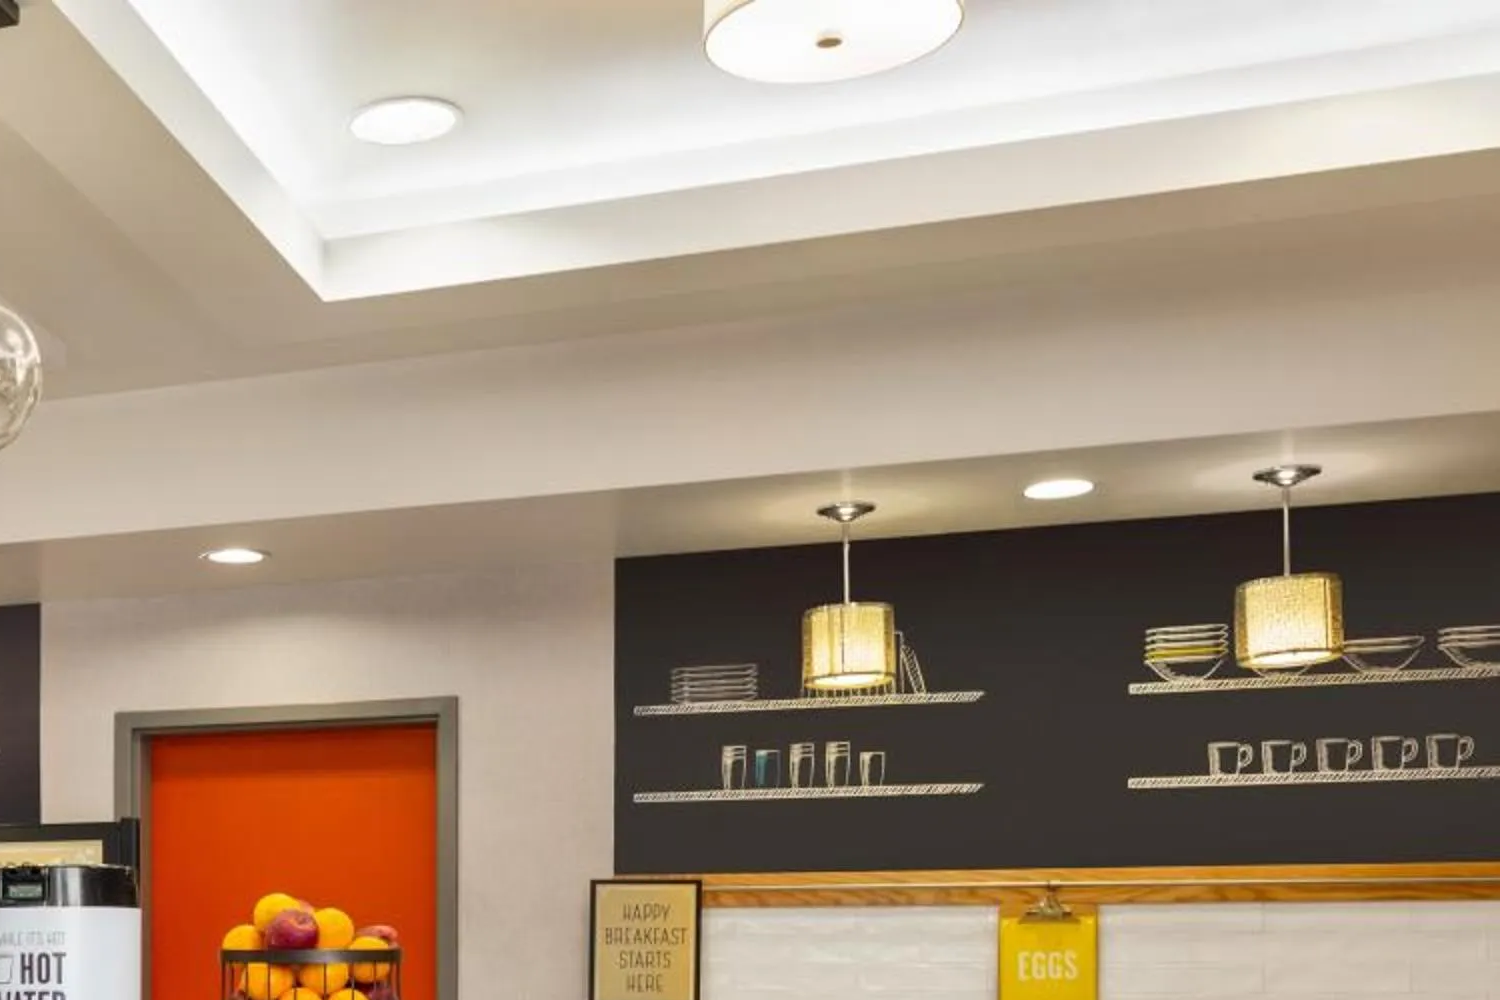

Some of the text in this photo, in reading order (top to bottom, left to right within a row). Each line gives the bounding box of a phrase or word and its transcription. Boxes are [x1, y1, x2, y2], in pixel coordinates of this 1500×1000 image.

[622, 903, 671, 921] HAPPY
[605, 927, 688, 945] BREAKFAST
[19, 951, 67, 985] HOT
[619, 950, 671, 969] STARTS
[1018, 950, 1078, 981] EGGS
[626, 974, 664, 993] HERE
